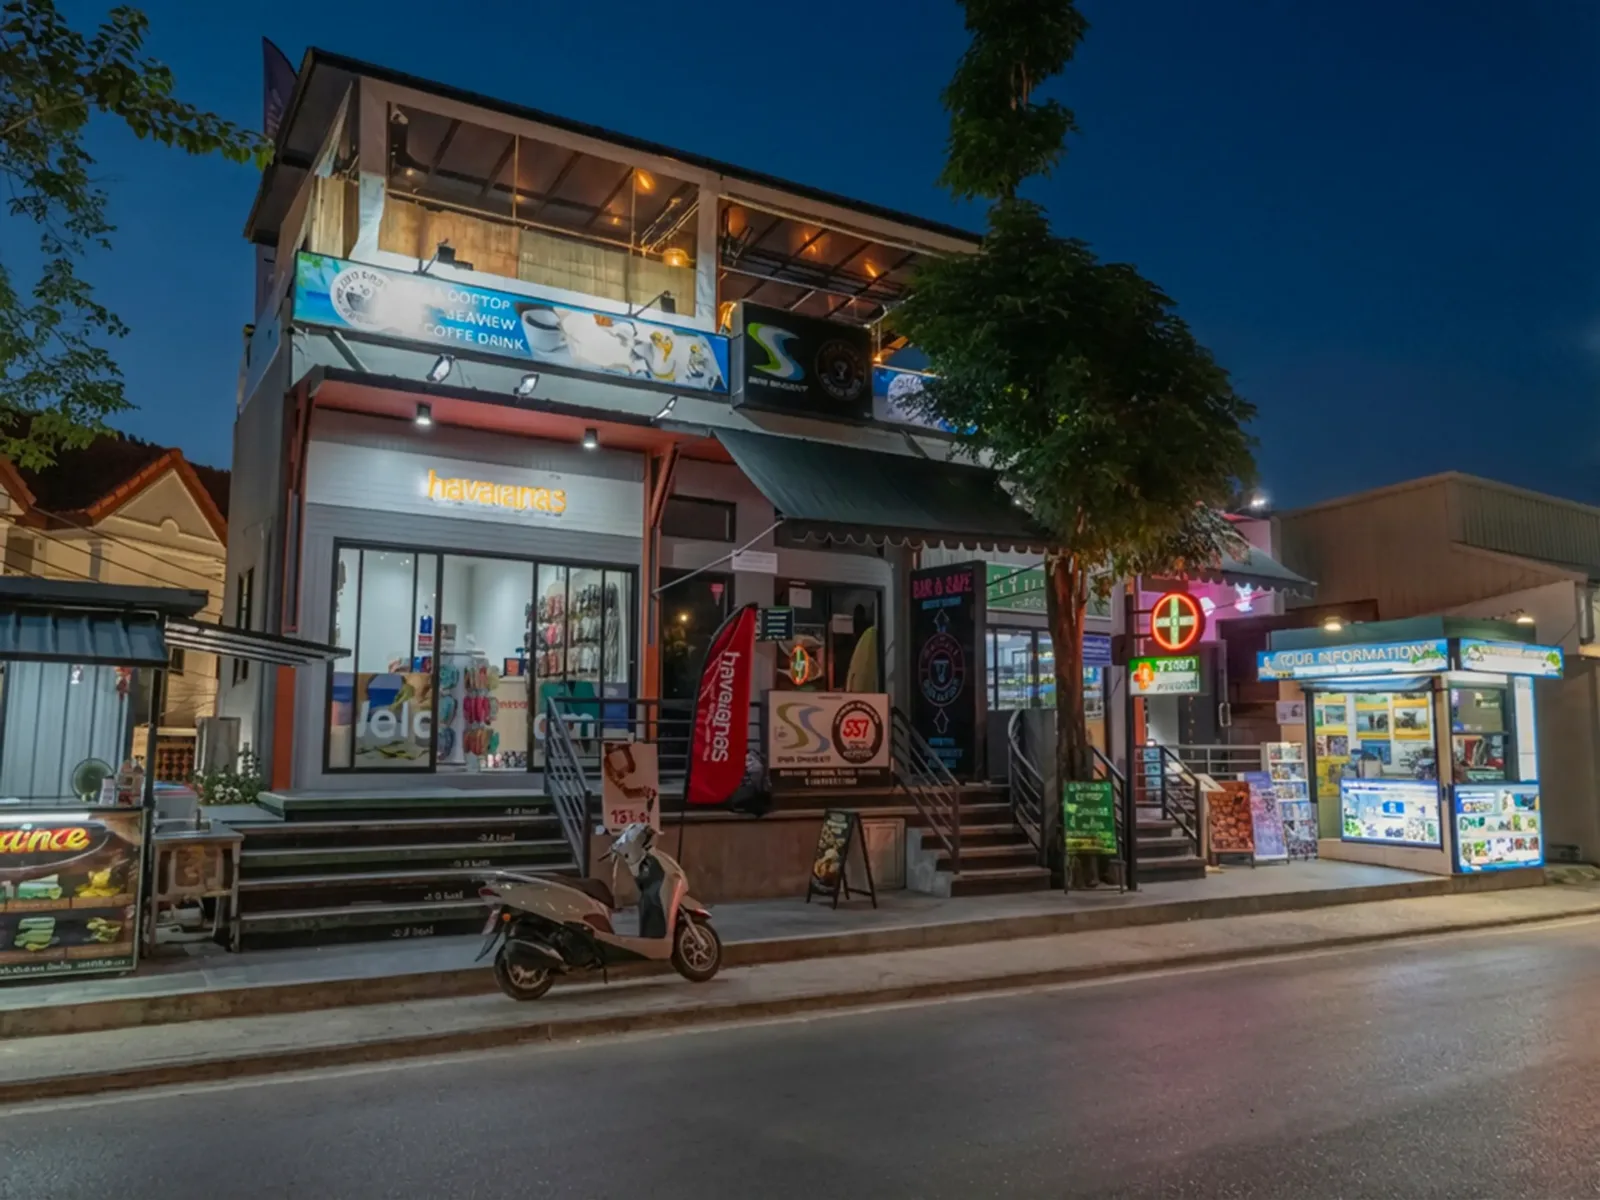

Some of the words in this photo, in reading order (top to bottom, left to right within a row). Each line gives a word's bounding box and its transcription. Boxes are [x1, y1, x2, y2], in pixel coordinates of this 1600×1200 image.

[478, 332, 524, 351] DRINK
[428, 468, 567, 513] havaianas
[1318, 645, 1424, 665] INFORMATION
